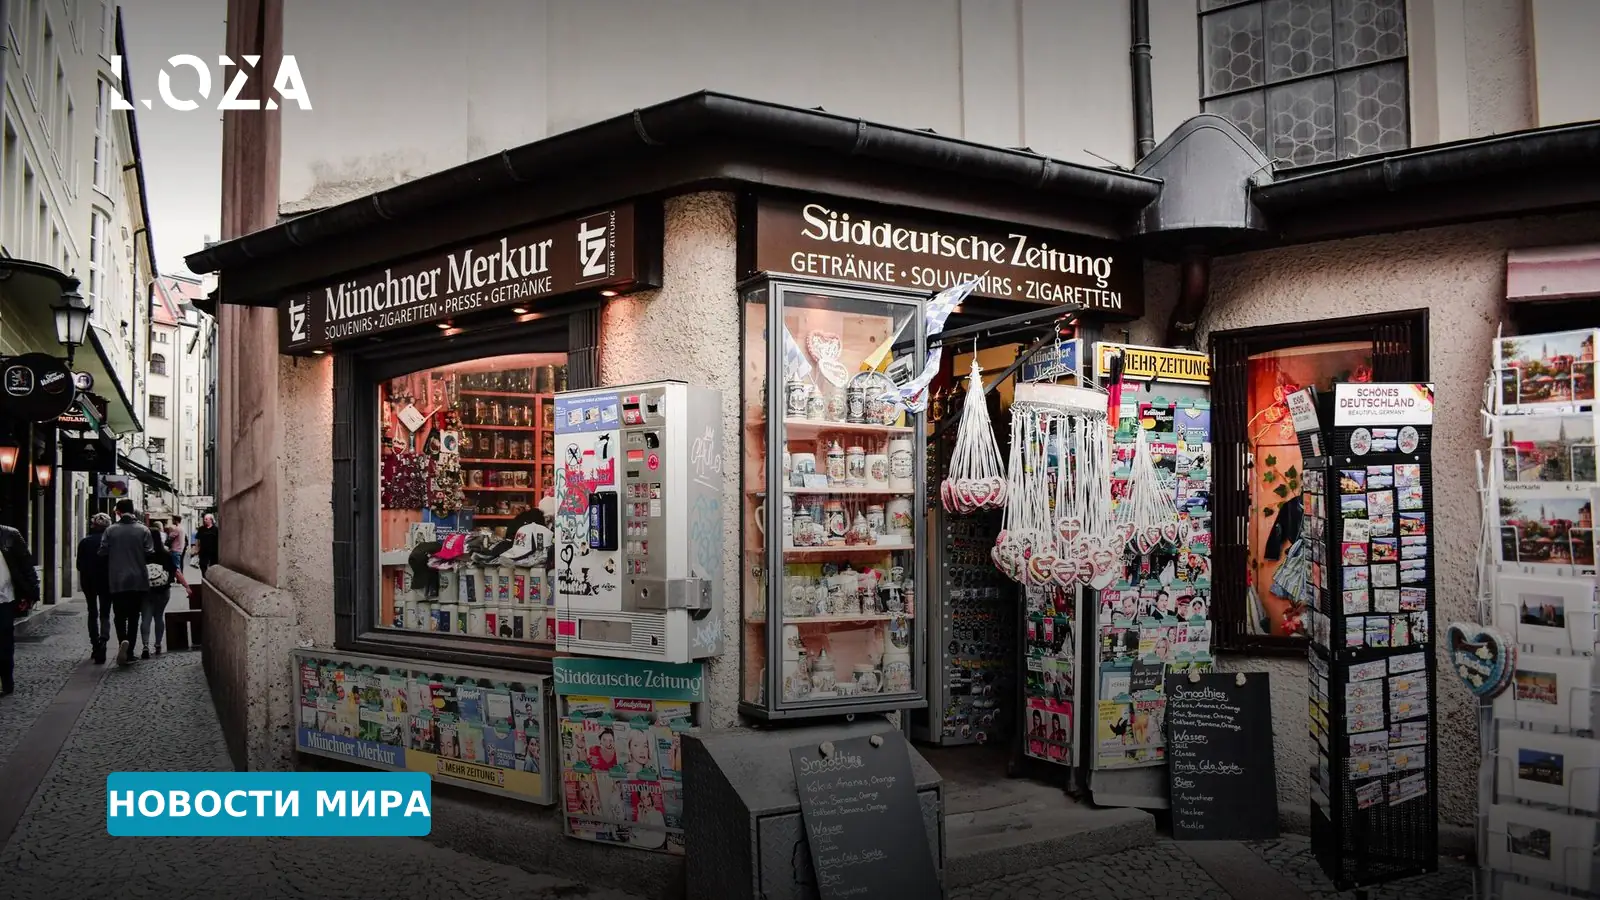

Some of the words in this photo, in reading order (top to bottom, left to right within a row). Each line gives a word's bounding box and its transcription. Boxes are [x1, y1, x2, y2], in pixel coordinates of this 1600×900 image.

[577, 222, 607, 277] tz
[801, 203, 1006, 265] Süddeutsche
[1008, 234, 1113, 289] Zeitung
[325, 266, 441, 323] Münchner
[446, 237, 552, 294] Merkur
[791, 251, 895, 283] GETRÄNKE
[911, 266, 1012, 296] SOUVENIRS
[1025, 280, 1122, 310] ZIGARETTEN
[324, 316, 373, 341] SOUVENIRS
[379, 302, 437, 328] ZIGARETTEN
[445, 292, 482, 314] PRESSE
[491, 276, 552, 302] GETRÄNKE
[288, 299, 306, 342] tz
[1159, 357, 1210, 377] ZEITUNG
[1357, 387, 1399, 397] SCHÖNES
[1340, 398, 1415, 408] DEUTSCHLAND
[555, 667, 643, 688] Süddeutsche
[643, 669, 702, 695] Zeitung
[1174, 684, 1226, 699] Smoothies
[1173, 730, 1207, 742] Wasser
[307, 731, 356, 757] Münchner
[357, 740, 395, 765] Merkur
[800, 750, 862, 772] Smoothies
[445, 762, 465, 775] MEHR
[466, 767, 495, 782] ZEITUNG
[870, 775, 896, 788] Orange
[1180, 792, 1214, 804] Augustiner
[1180, 807, 1204, 816] Hacker
[811, 821, 843, 834] Wasser
